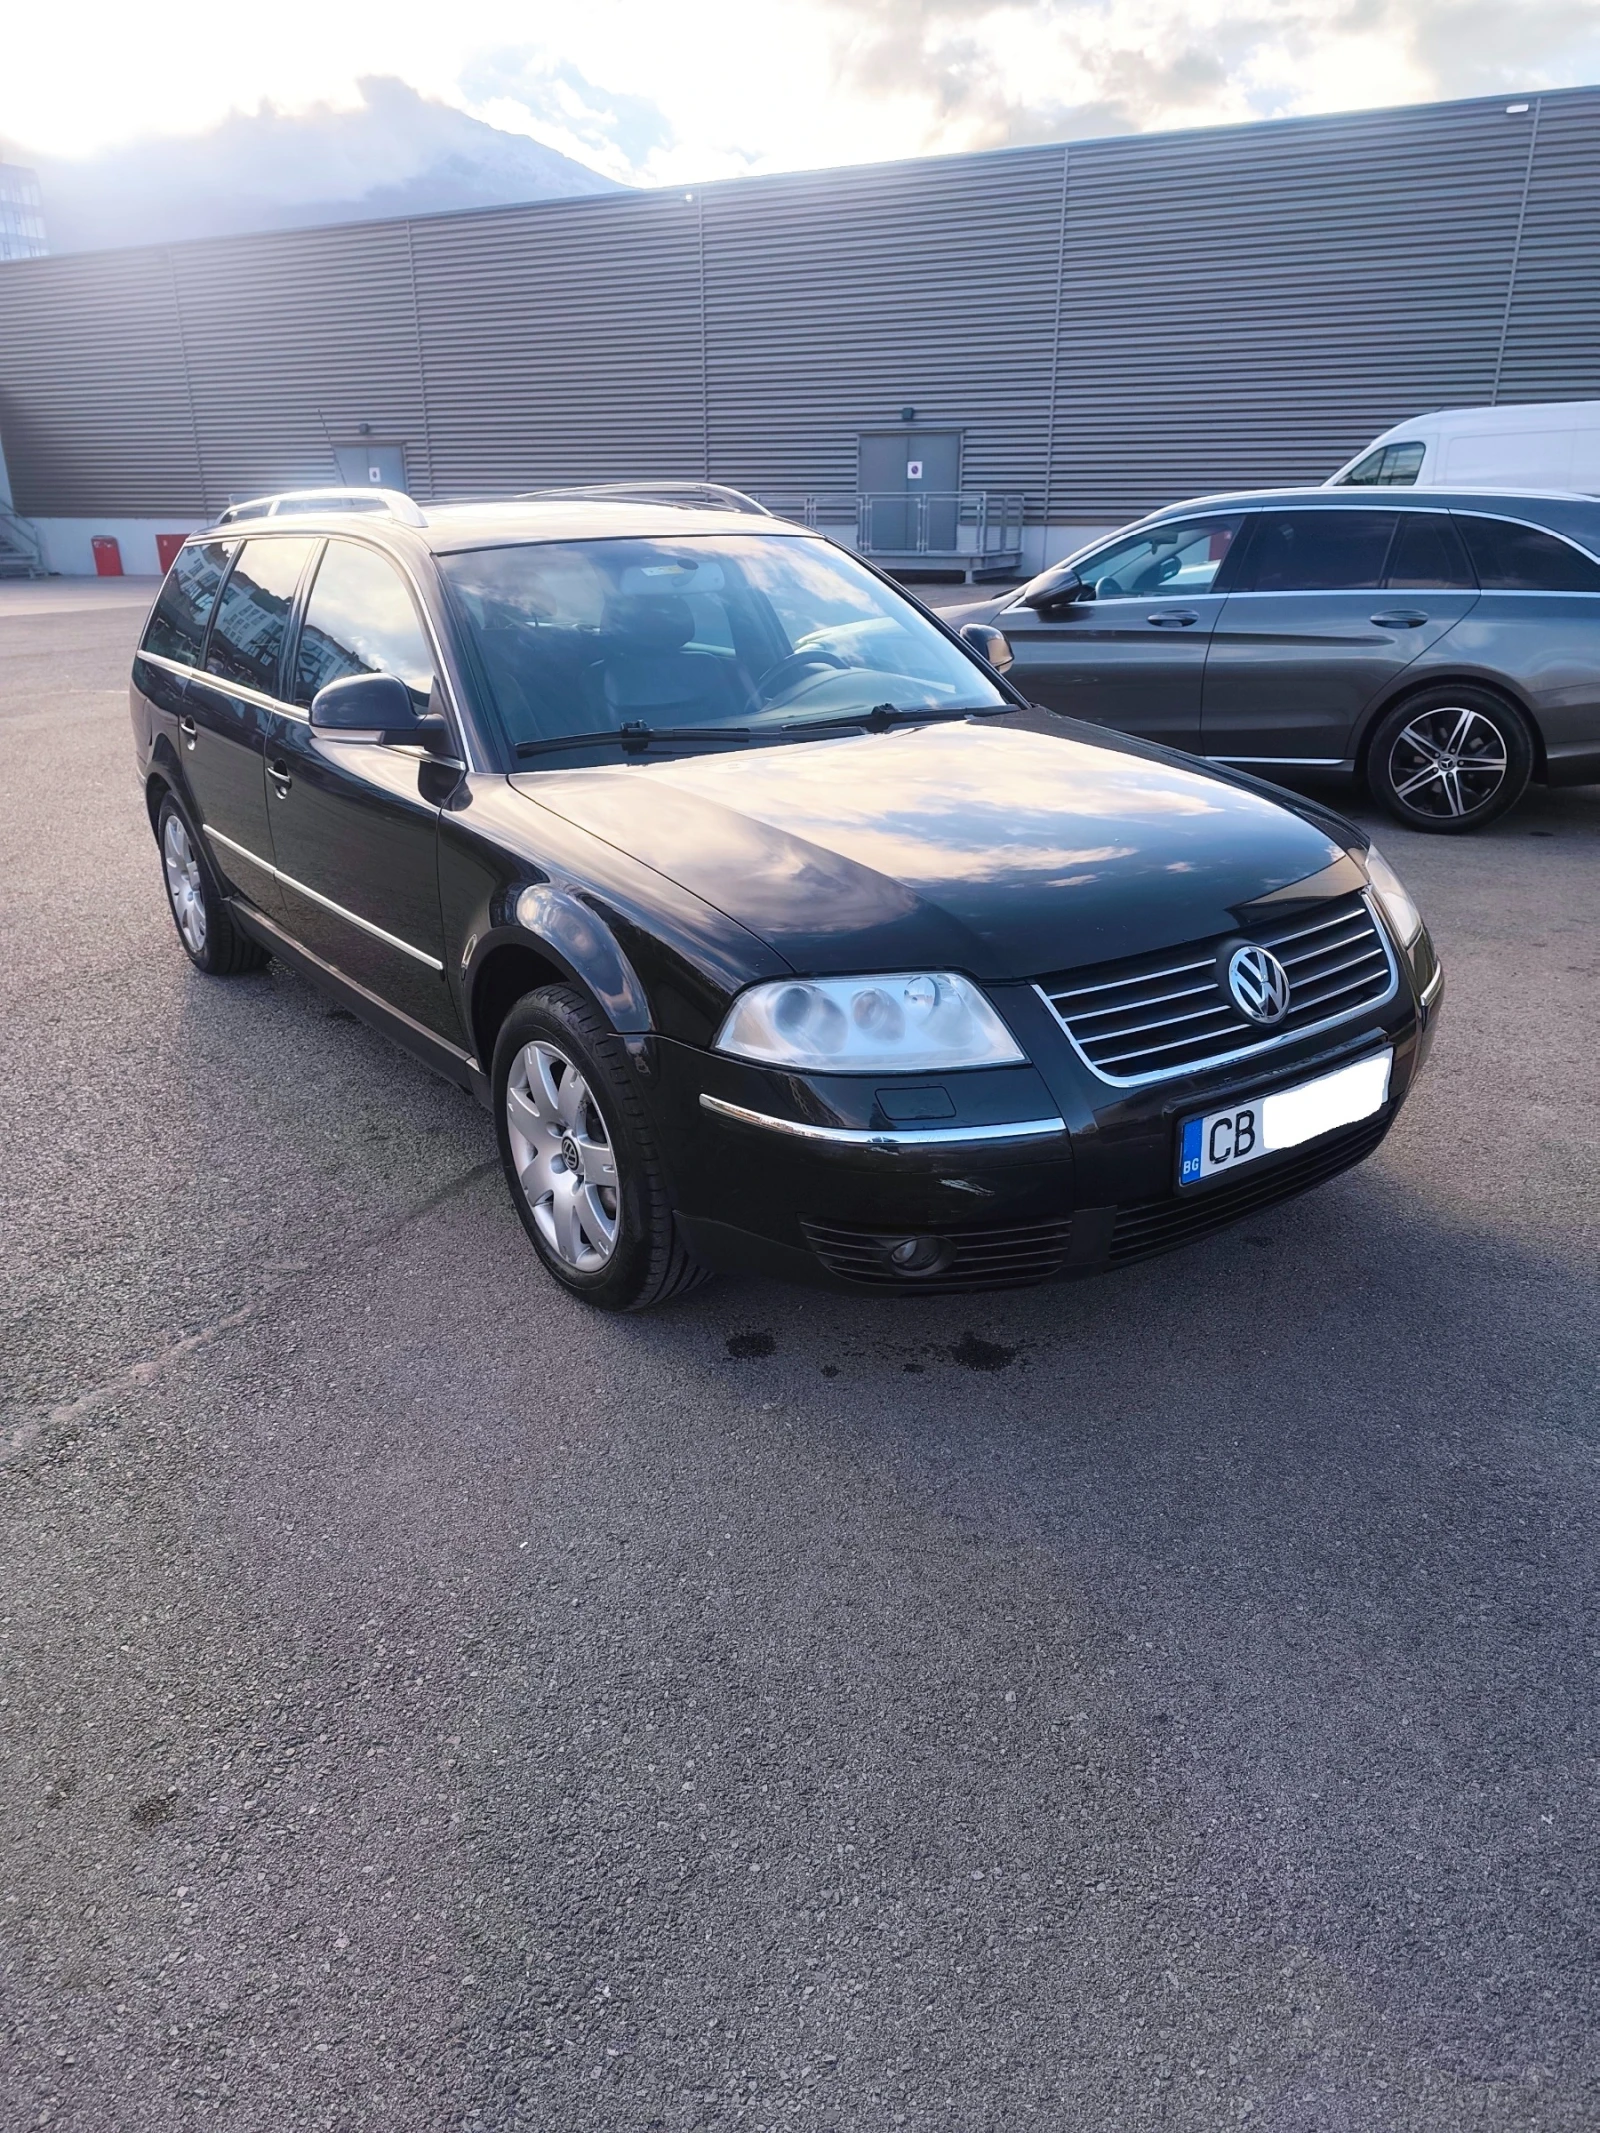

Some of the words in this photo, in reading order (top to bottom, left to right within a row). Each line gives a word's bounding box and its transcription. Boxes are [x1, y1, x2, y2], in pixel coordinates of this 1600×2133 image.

[1229, 946, 1290, 1023] VW
[1209, 1109, 1256, 1165] CB
[1183, 1157, 1199, 1175] BG
